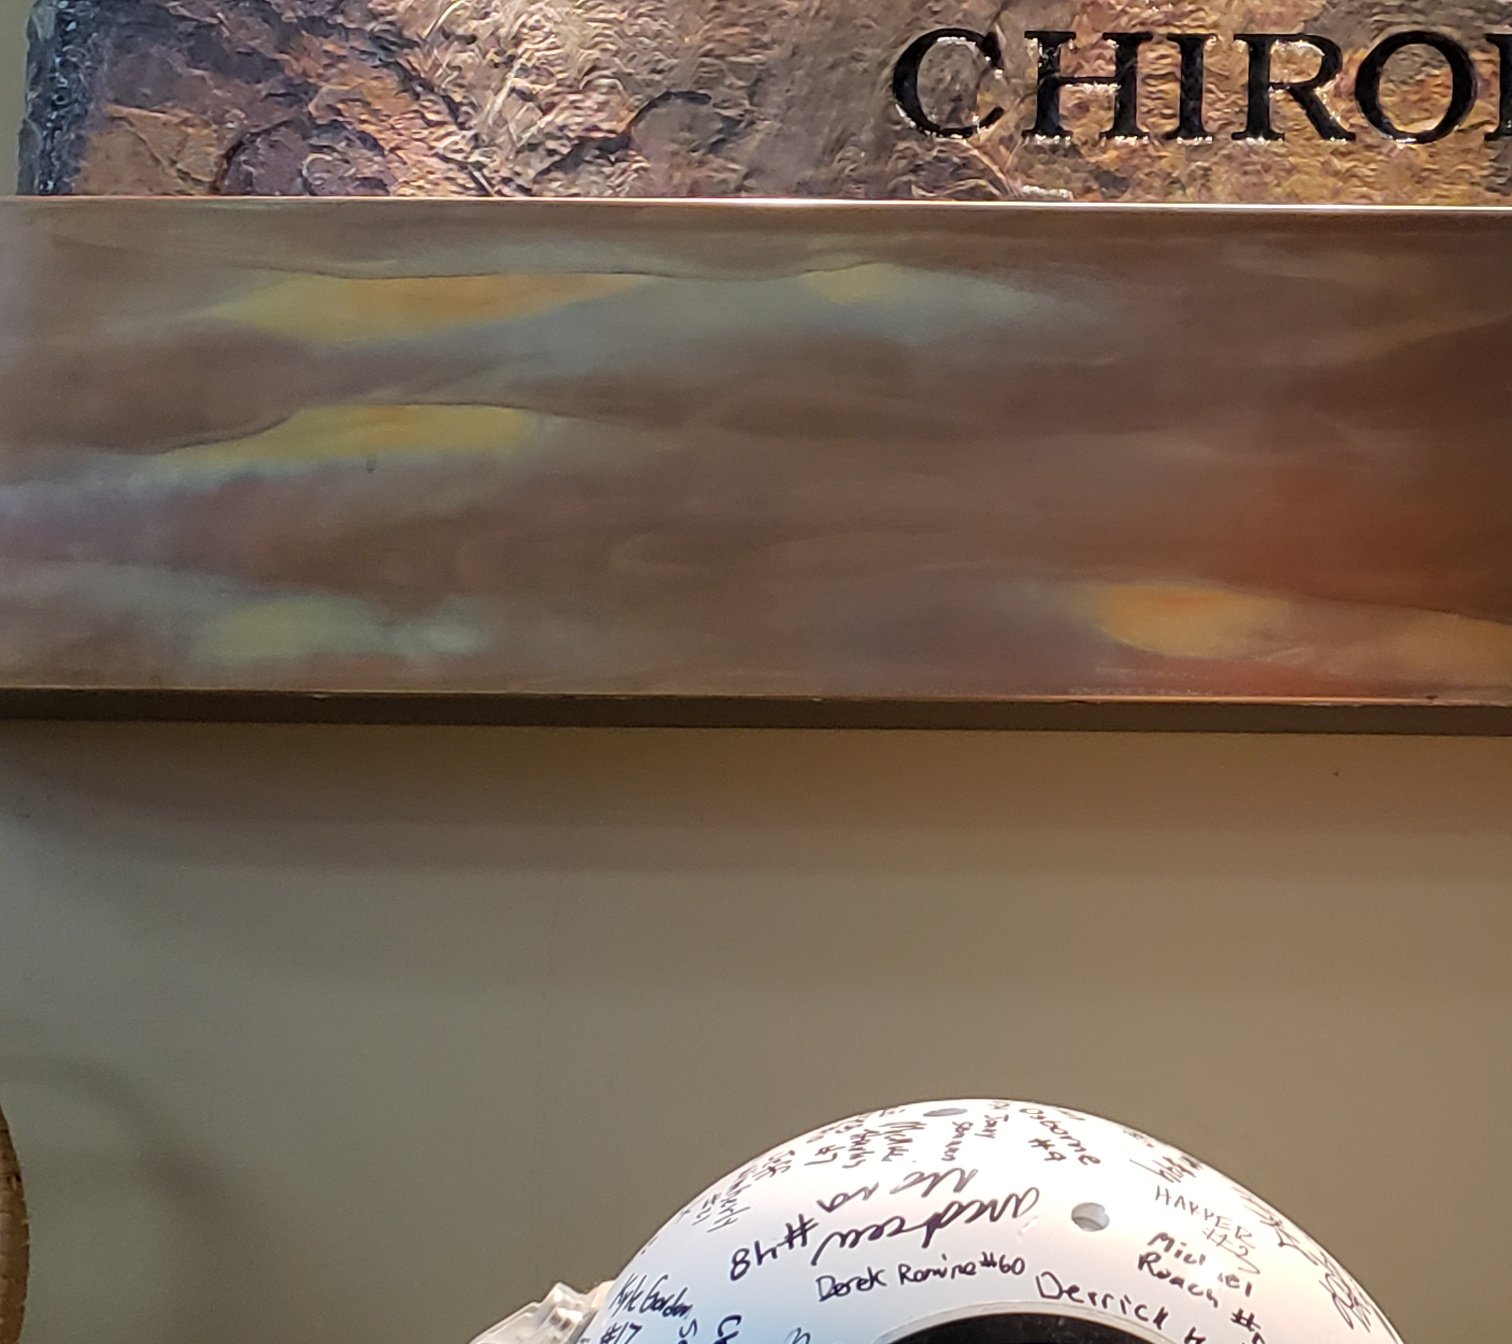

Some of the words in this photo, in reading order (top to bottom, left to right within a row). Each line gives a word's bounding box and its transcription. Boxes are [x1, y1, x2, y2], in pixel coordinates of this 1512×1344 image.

[729, 1213, 819, 1282] #48
[816, 1266, 887, 1303] Derek
[1035, 1269, 1169, 1330] Derrick
